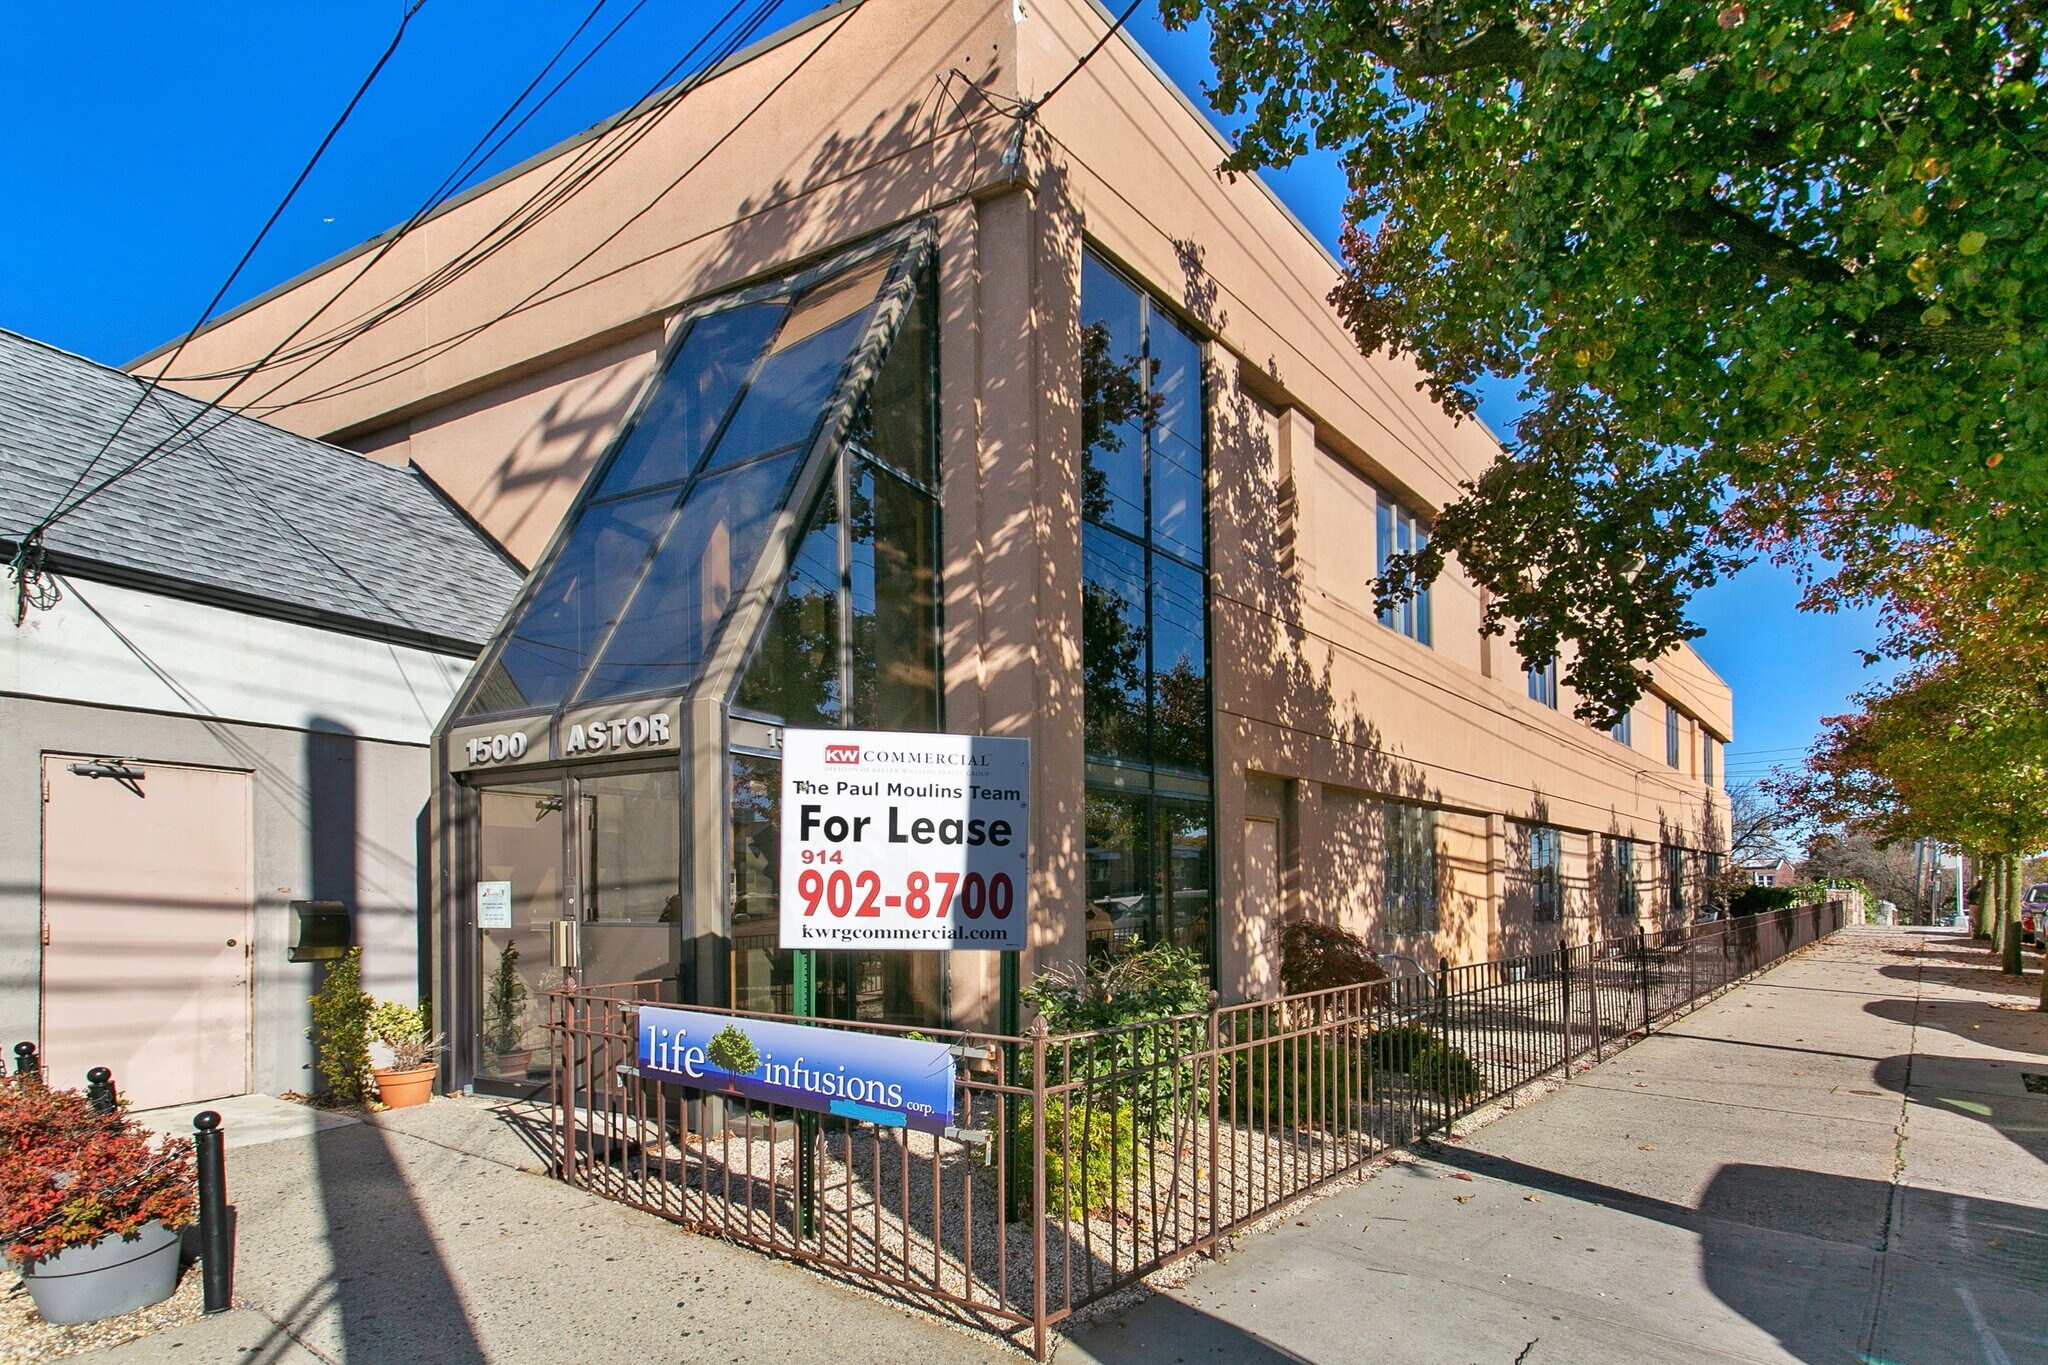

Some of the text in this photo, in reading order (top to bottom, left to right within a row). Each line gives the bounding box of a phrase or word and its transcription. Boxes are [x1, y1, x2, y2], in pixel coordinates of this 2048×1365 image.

[466, 713, 670, 764] 1500 ASTOR
[825, 747, 990, 767] KW COMMERCIAL
[793, 780, 1020, 801] The Paul Moulins Team
[800, 804, 1012, 846] For Lease
[801, 850, 843, 864] 914
[798, 869, 1013, 920] 902-8700
[802, 924, 1007, 942] kwrgcommercial.com
[647, 1025, 935, 1115] life infusions corp.
